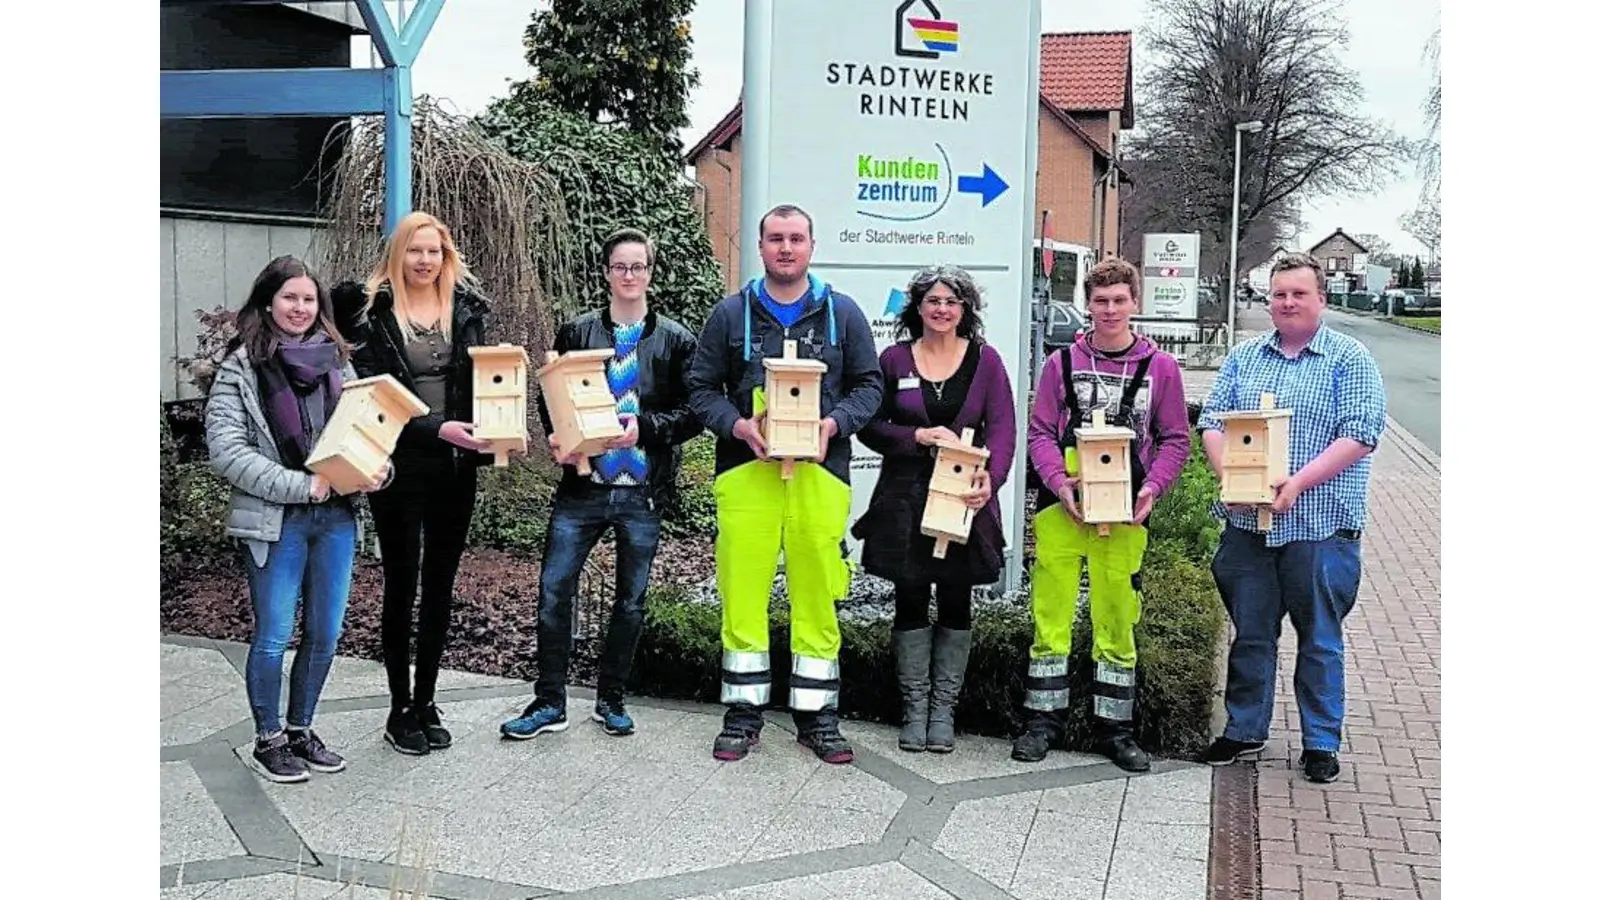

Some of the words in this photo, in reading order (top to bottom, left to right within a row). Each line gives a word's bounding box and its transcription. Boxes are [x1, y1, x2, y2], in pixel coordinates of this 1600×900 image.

[826, 63, 993, 95] STADTWERKE
[860, 94, 969, 121] RINTELN
[858, 154, 939, 180] Kunden
[857, 181, 938, 203] zentrum
[839, 228, 861, 243] der
[865, 228, 934, 245] Stadtwerke
[936, 231, 975, 246] Rinteln
